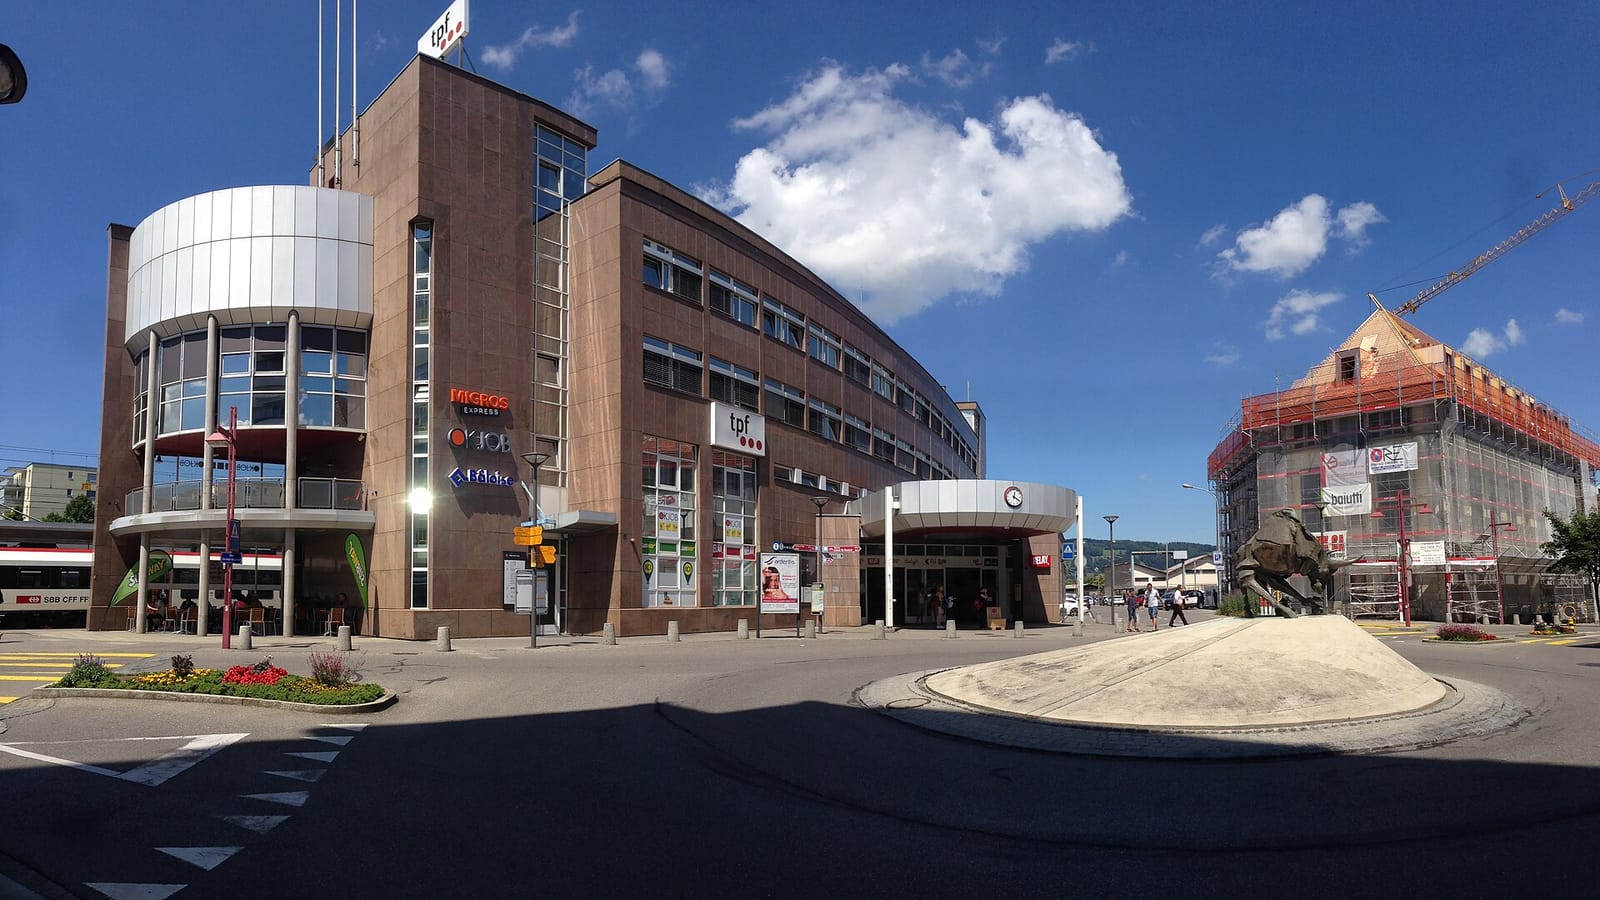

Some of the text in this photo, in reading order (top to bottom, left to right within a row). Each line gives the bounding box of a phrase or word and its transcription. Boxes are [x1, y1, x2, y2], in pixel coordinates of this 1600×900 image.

[431, 11, 450, 47] tpf
[450, 388, 509, 410] MIGROS
[463, 406, 499, 415] EXPRESS
[730, 412, 750, 437] tpf
[1331, 491, 1363, 505] baiutti
[44, 596, 60, 604] SBB
[62, 596, 78, 604] CFF
